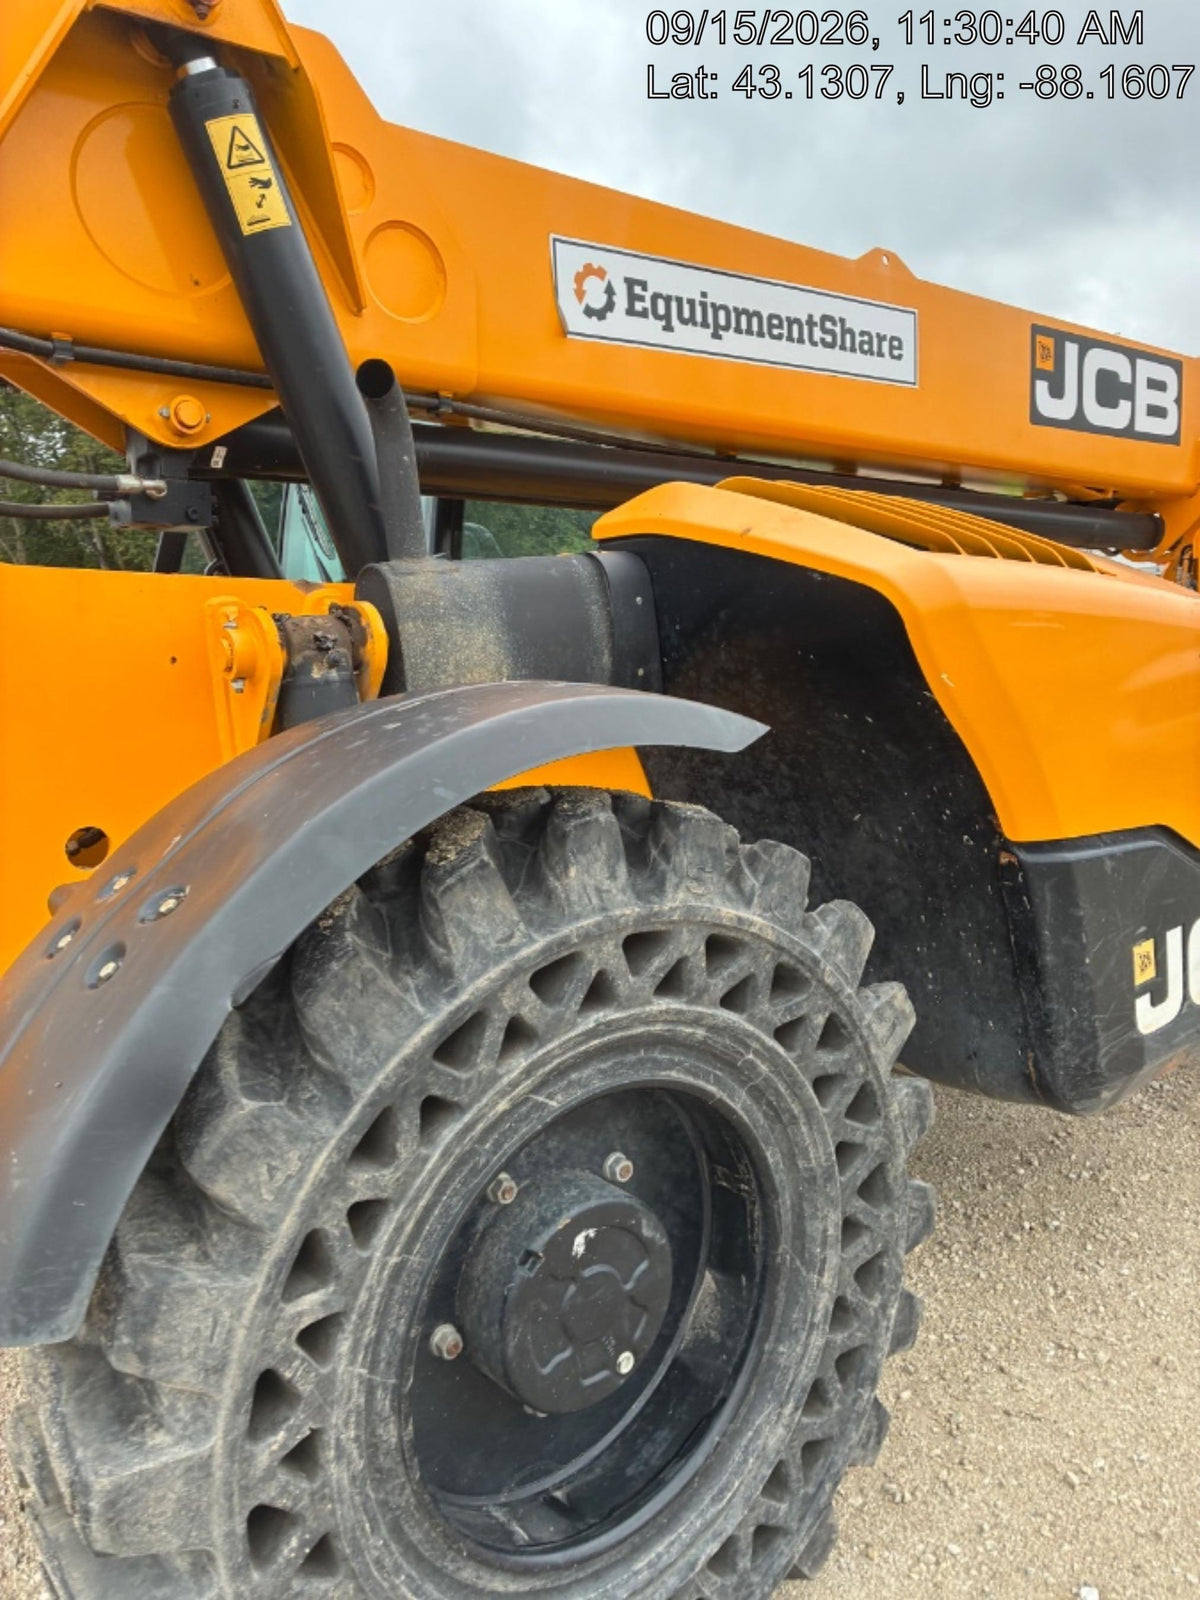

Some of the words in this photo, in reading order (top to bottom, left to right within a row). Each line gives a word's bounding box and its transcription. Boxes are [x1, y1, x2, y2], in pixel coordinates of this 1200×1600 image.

[623, 276, 905, 361] EquipmentShare
[1035, 341, 1179, 436] JCB
[1135, 918, 1200, 1035] J
